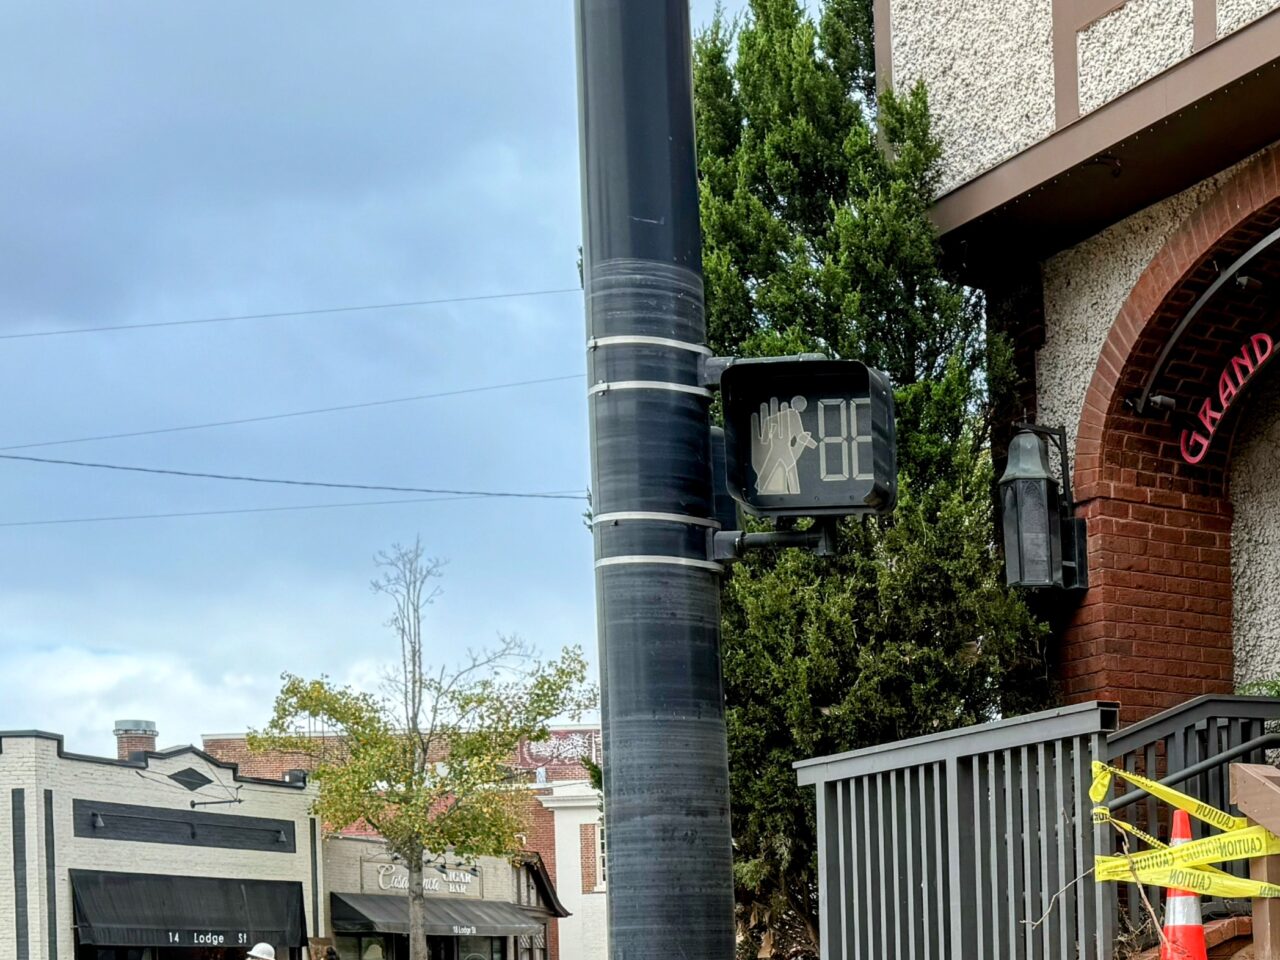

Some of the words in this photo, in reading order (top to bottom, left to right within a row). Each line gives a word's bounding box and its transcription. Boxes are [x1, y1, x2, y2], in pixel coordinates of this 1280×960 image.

[1180, 332, 1275, 464] GRAND
[377, 864, 439, 890] Casanca
[449, 883, 467, 893] BAR
[168, 931, 180, 944] 14
[193, 931, 224, 946] Lodge
[238, 932, 247, 944] St
